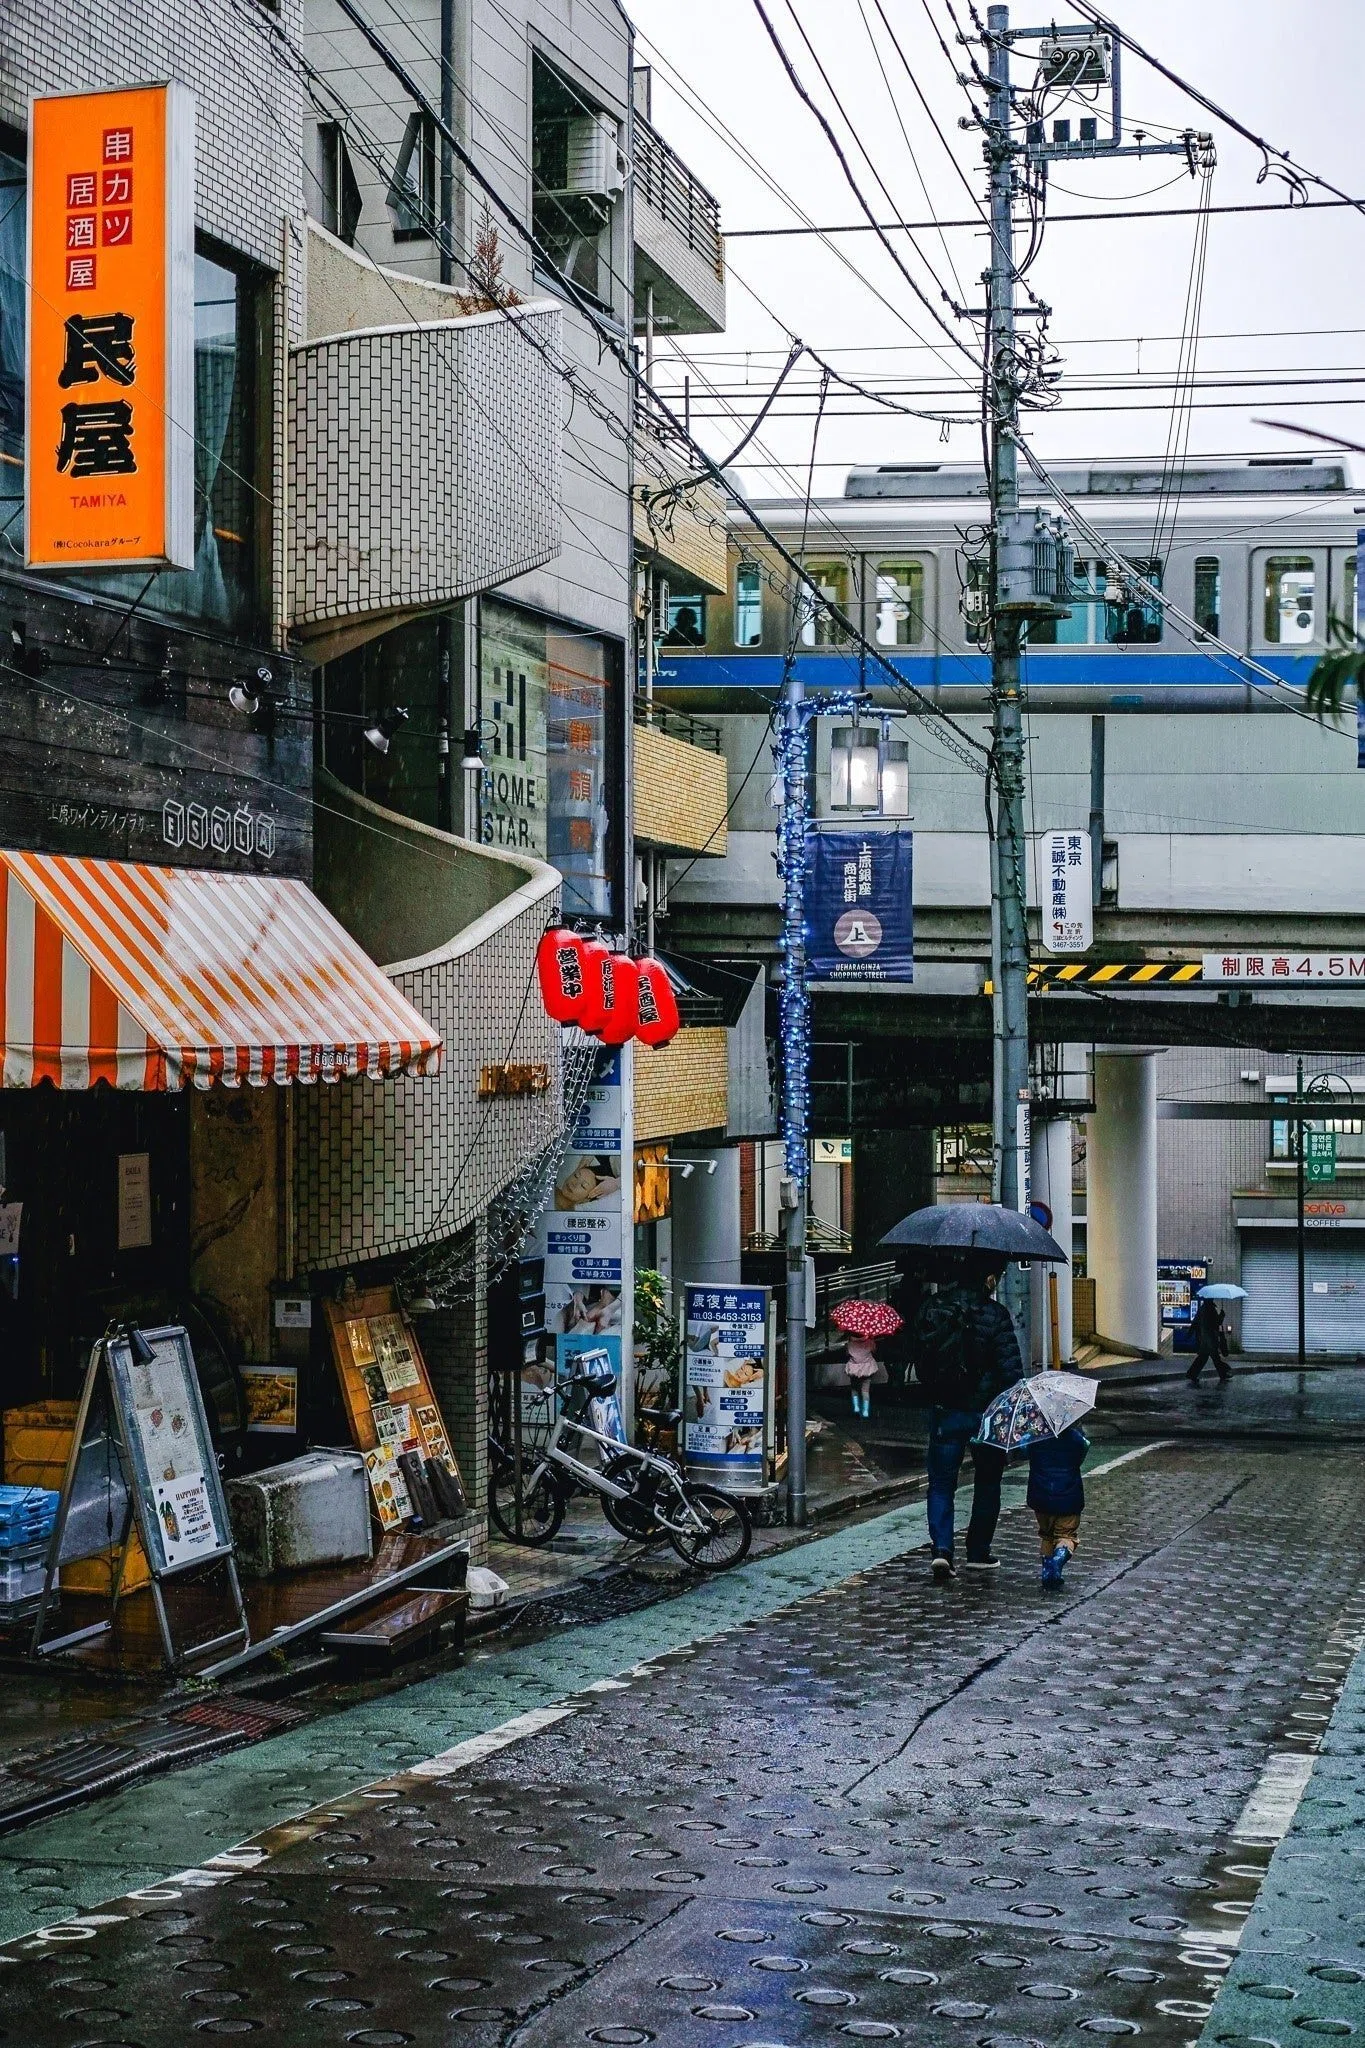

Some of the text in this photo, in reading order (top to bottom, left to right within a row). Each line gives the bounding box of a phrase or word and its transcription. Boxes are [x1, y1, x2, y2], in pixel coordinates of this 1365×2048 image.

[105, 132, 131, 243] 串カツ
[68, 176, 95, 287] 居酒屋
[55, 312, 138, 479] 民屋
[70, 494, 127, 509] TAMIYA
[482, 770, 536, 808] HOME
[163, 803, 273, 857] ESOLA
[484, 811, 536, 849] STAR.
[1067, 835, 1082, 866] 東京
[844, 862, 857, 903] 商店街
[858, 842, 872, 896] 上原銀座
[1051, 836, 1067, 919] 三誠不動産(株)
[850, 927, 865, 941] 上
[1052, 941, 1084, 949] 3467-3551
[829, 971, 887, 980] SHOPPING STREET
[835, 963, 881, 971] UEHARAGINZA
[567, 1219, 607, 1229] 腰部整体
[1306, 1219, 1341, 1227] COFFEE
[692, 1294, 738, 1309] 康復堂
